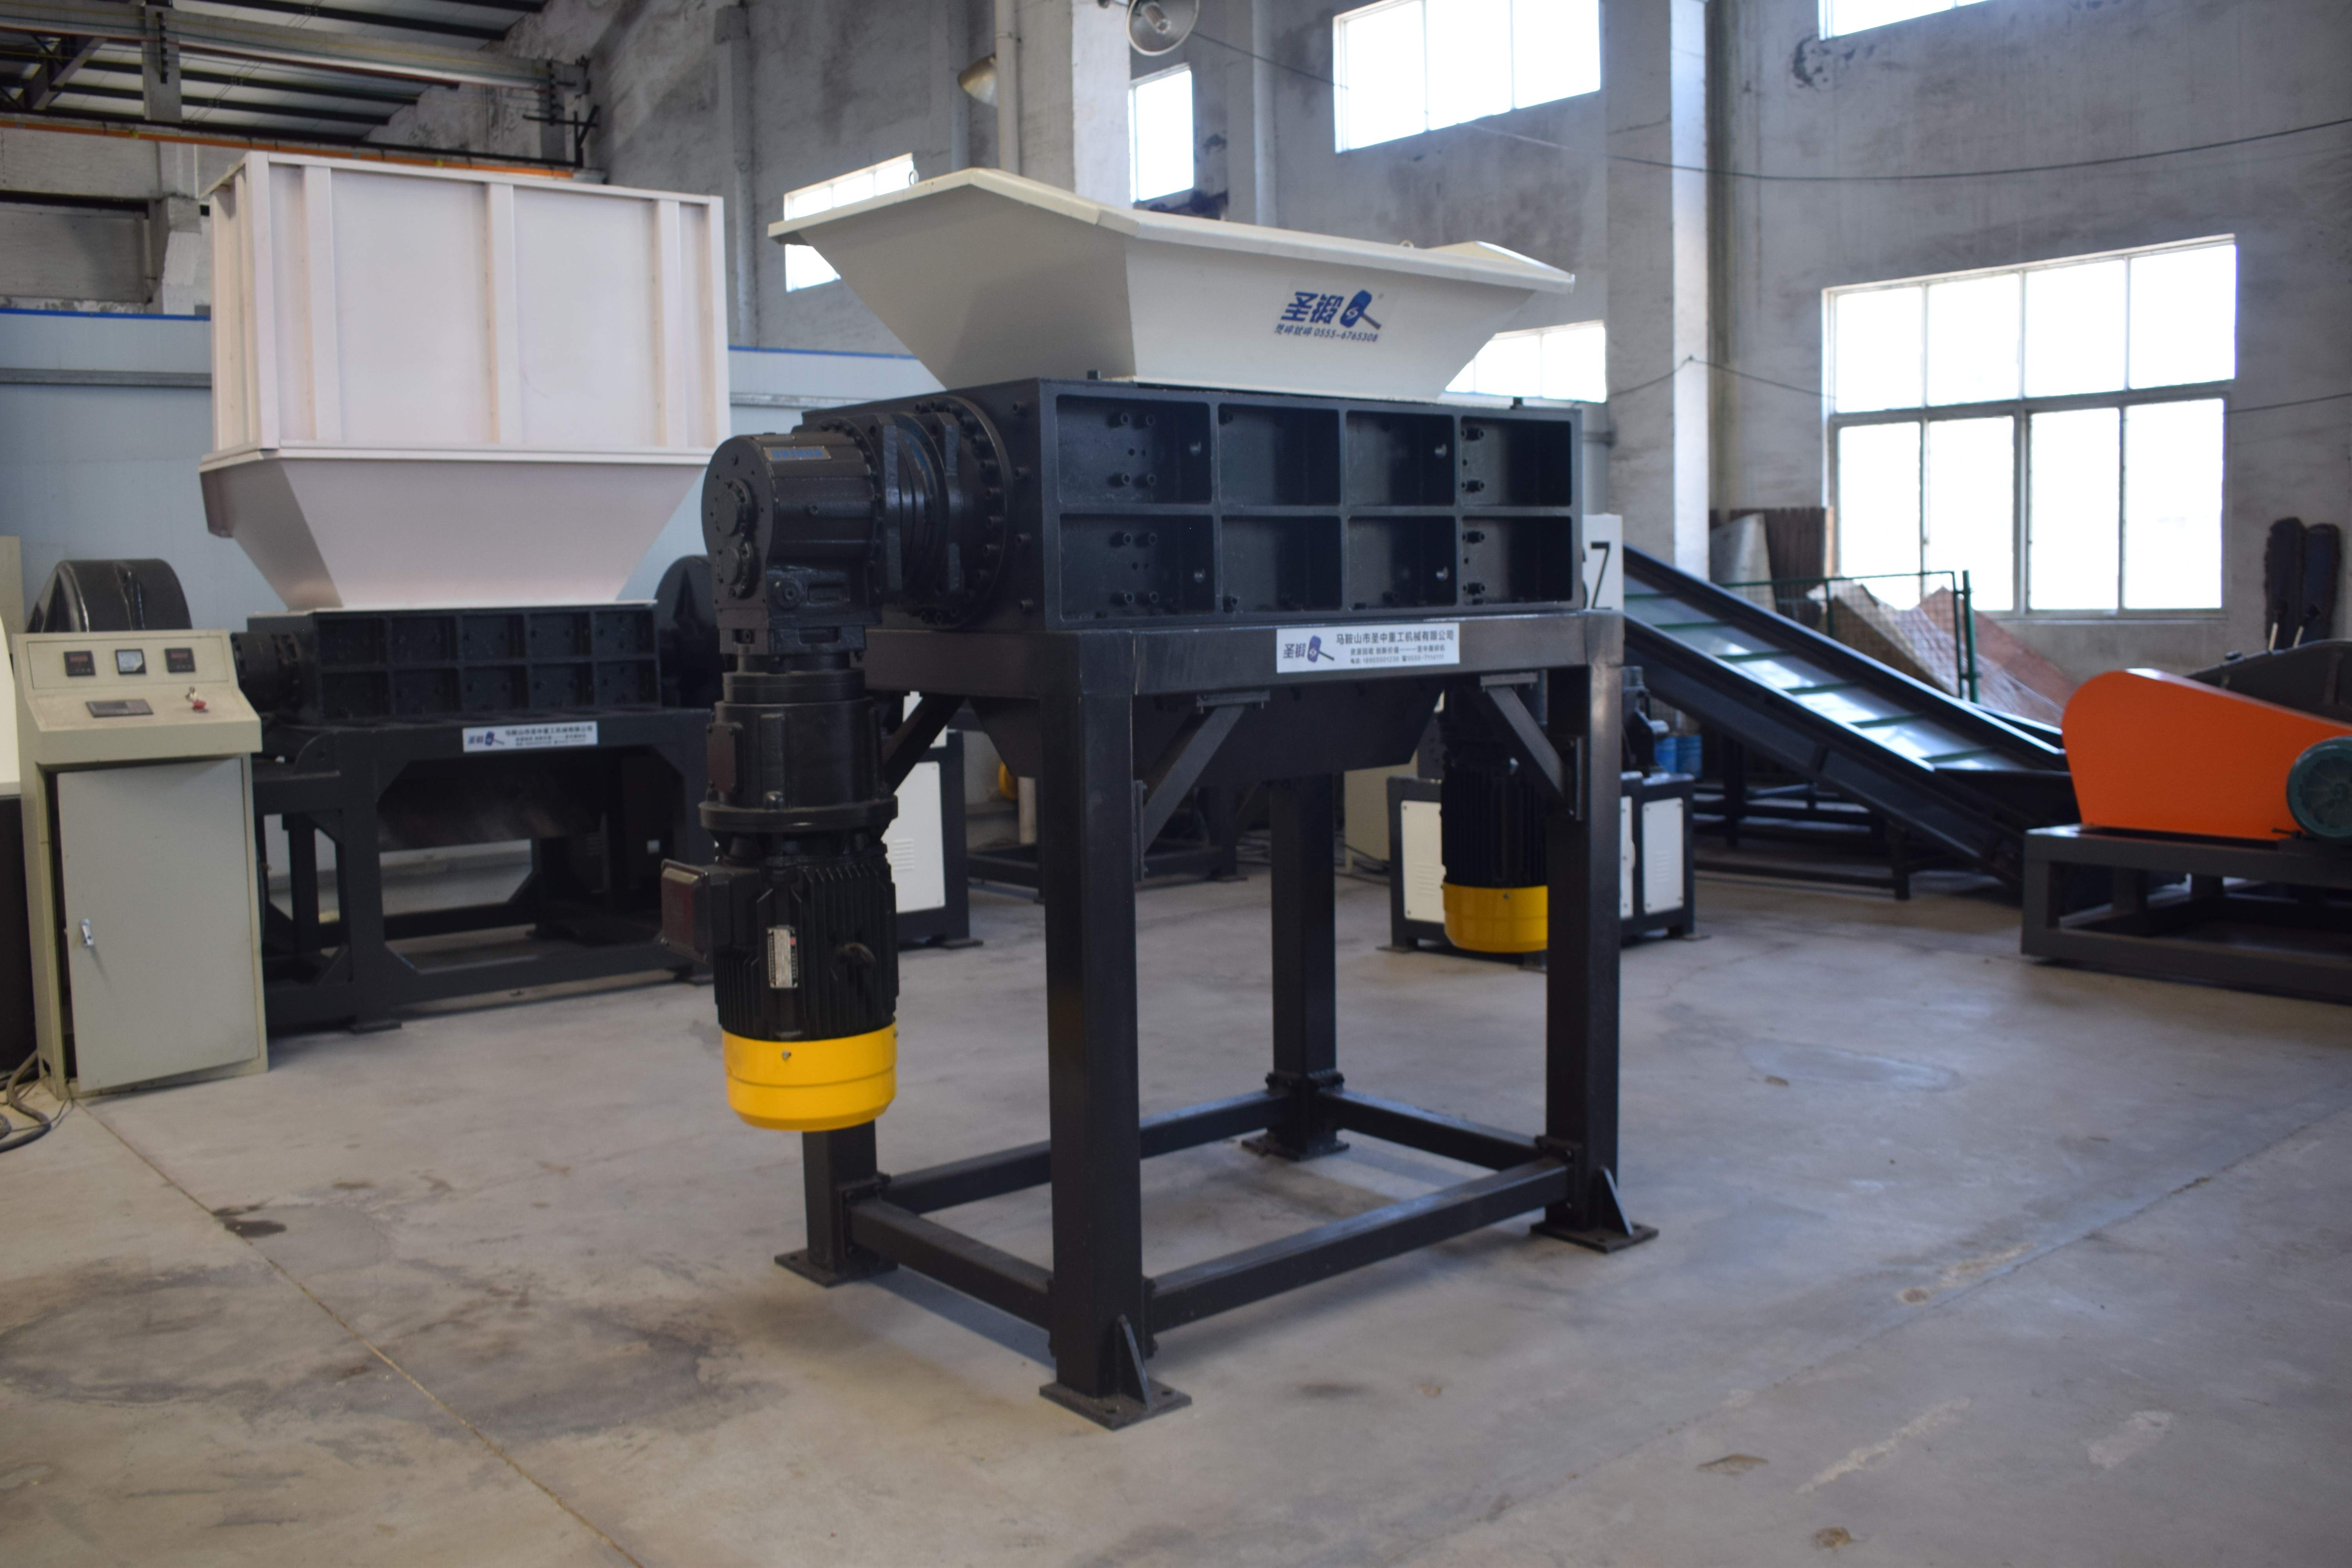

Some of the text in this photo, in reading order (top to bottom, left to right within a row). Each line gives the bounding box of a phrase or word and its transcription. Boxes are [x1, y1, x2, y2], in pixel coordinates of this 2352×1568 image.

[1314, 329, 1378, 342] 0555-6765308
[1336, 630, 1454, 645] 马鞍山市圣中重工机械有限公司
